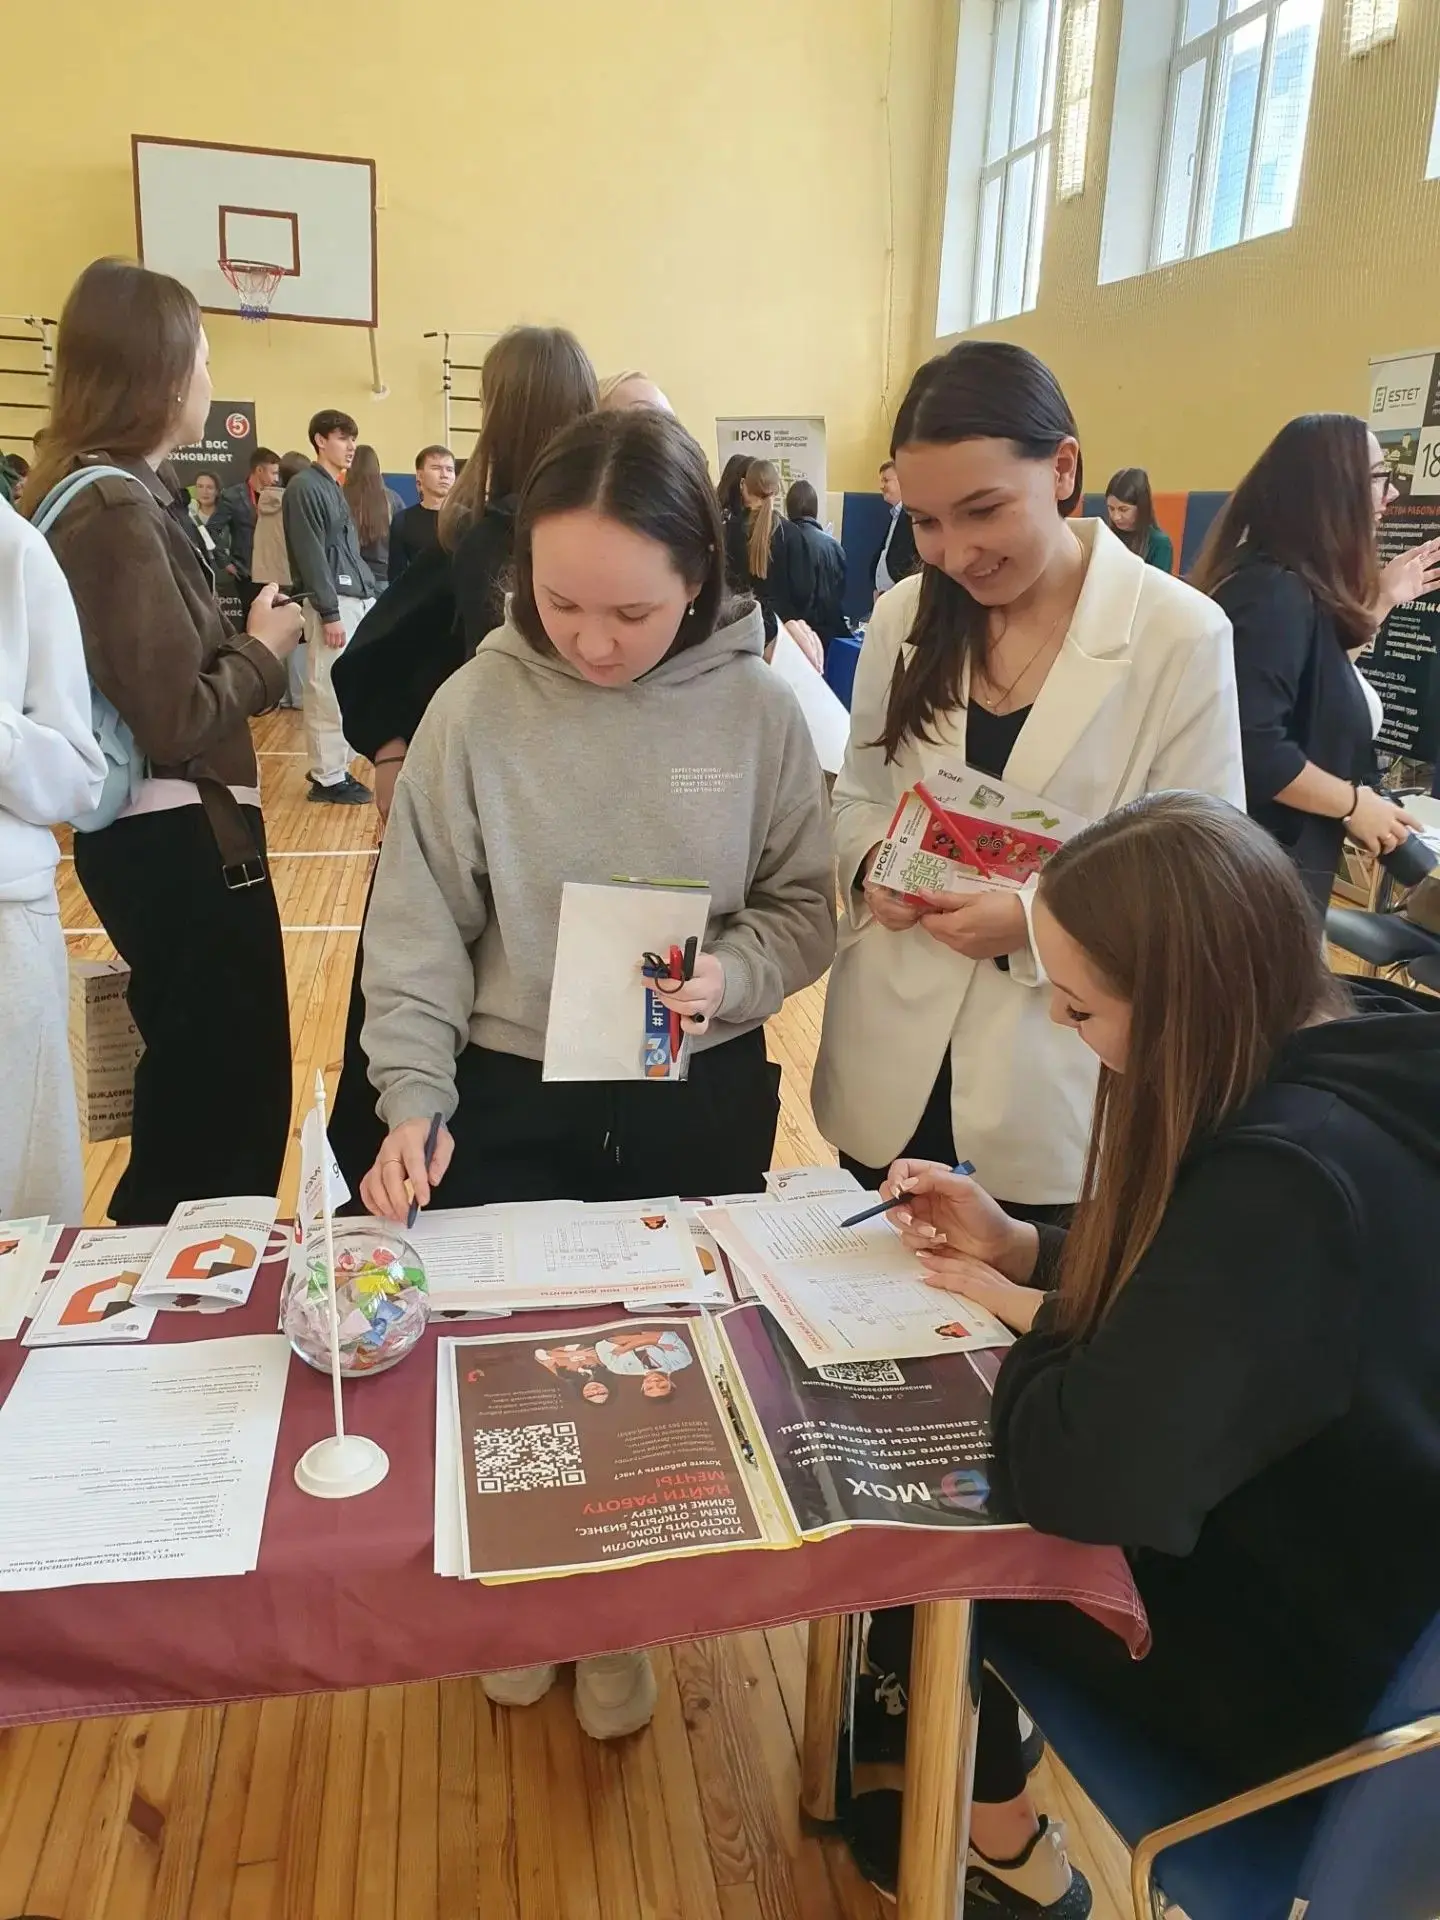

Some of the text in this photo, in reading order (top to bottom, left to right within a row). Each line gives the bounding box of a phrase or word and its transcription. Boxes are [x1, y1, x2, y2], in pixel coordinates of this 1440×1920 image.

[1388, 387, 1420, 402] ESTET
[741, 430, 771, 441] РСХБ
[206, 440, 228, 449] вас
[877, 842, 892, 871] РСХБ
[776, 1421, 815, 1434] МФЦ.
[830, 1422, 872, 1434] прием
[896, 1420, 978, 1433] запишитесь
[838, 1434, 886, 1445] работы
[890, 1436, 926, 1445] часы
[930, 1430, 986, 1441] узнаете
[871, 1449, 916, 1457] статус
[920, 1441, 992, 1454] проверите
[645, 1461, 687, 1472] работать
[796, 1455, 842, 1468] легко:
[867, 1461, 902, 1470] МФЦ
[905, 1457, 948, 1467] ботом
[614, 1471, 635, 1480] нас?
[655, 1470, 726, 1487] МЕЧТЫ
[582, 1484, 730, 1514] НАЙТИ РАБОТУ
[690, 1498, 734, 1509] БЛИЖЕ
[631, 1504, 675, 1519] ВЕЧЕРУ
[700, 1506, 737, 1517] ДНЕМ
[630, 1511, 689, 1530] ОТКРЫТЬ
[575, 1523, 627, 1536] БИЗНЕС,
[627, 1516, 741, 1538] ПОСТРОИТЬ ДОМ,
[602, 1526, 745, 1552] УТРОМ МЫ ПОМОГЛИ
